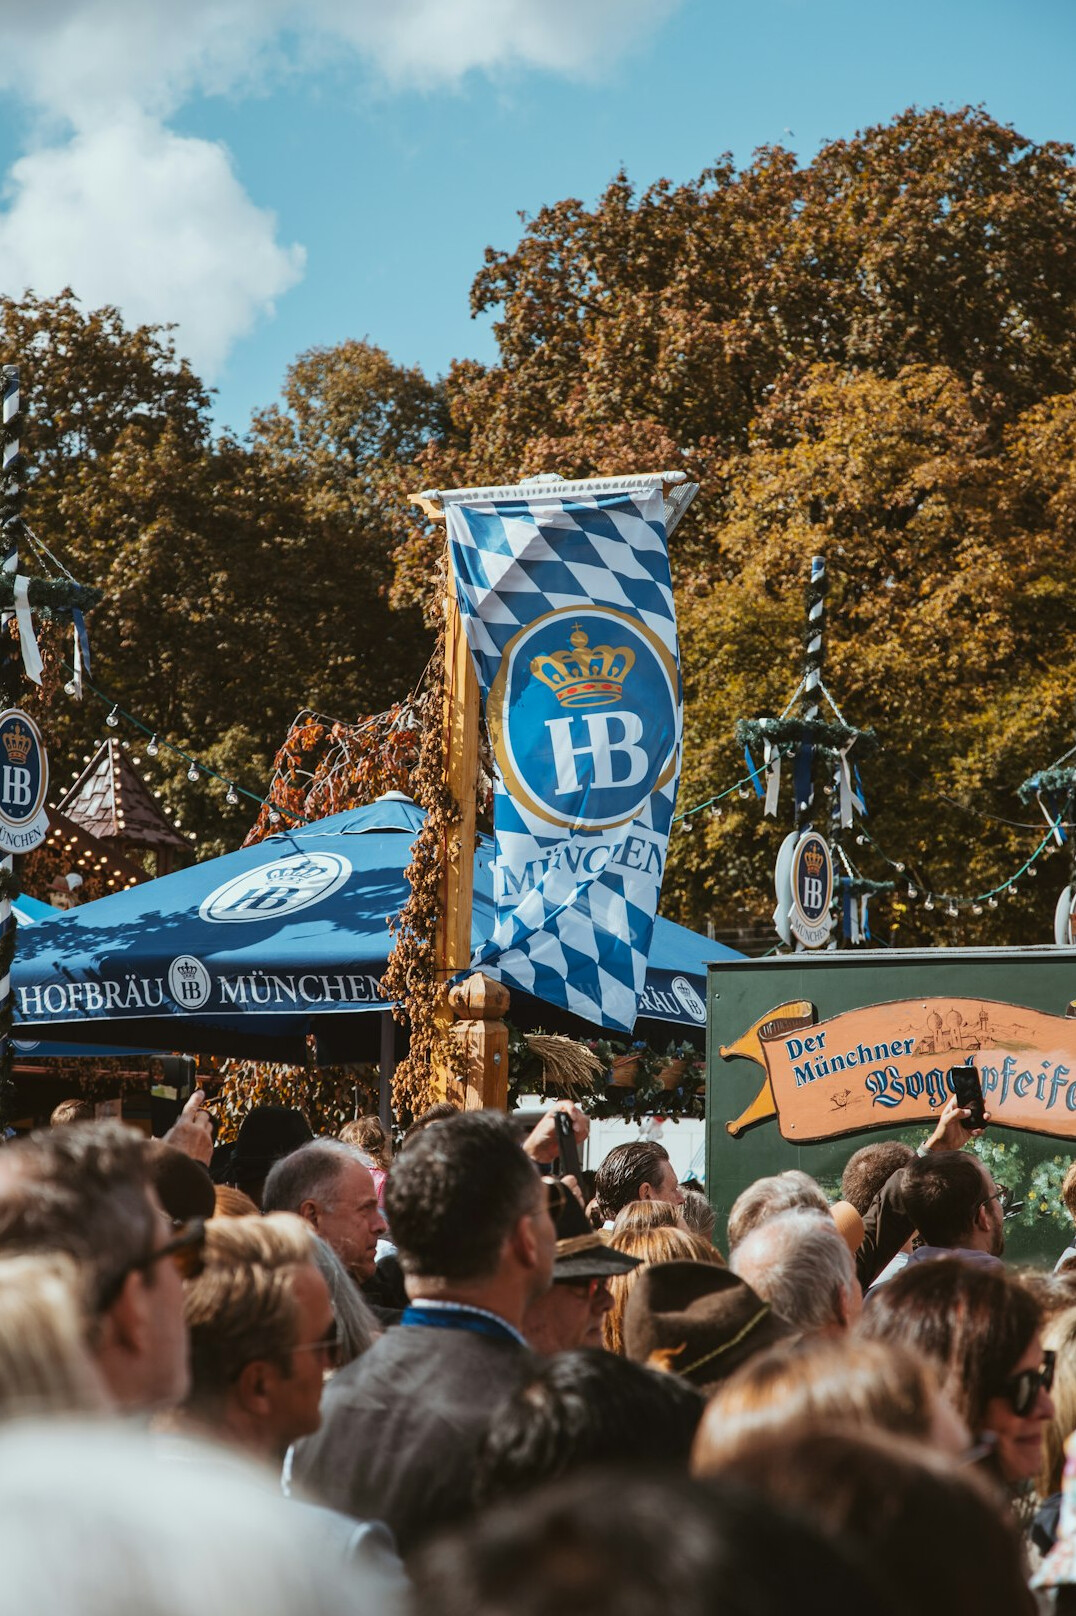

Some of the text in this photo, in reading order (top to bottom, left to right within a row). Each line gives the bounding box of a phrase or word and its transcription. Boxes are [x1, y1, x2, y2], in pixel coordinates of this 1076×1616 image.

[544, 710, 649, 796] HB
[2, 765, 32, 806] HB
[0, 825, 42, 848] ÜNCHEN
[501, 835, 667, 897] MÜNCEN
[222, 886, 300, 912] HB
[803, 876, 823, 909] HB
[795, 919, 829, 942] MÜNCHEN
[18, 974, 164, 1015] HOFBRÄU
[181, 981, 201, 1000] HB
[638, 985, 681, 1015] RÄU
[785, 1031, 826, 1061] Der
[793, 1037, 916, 1088] Münchner
